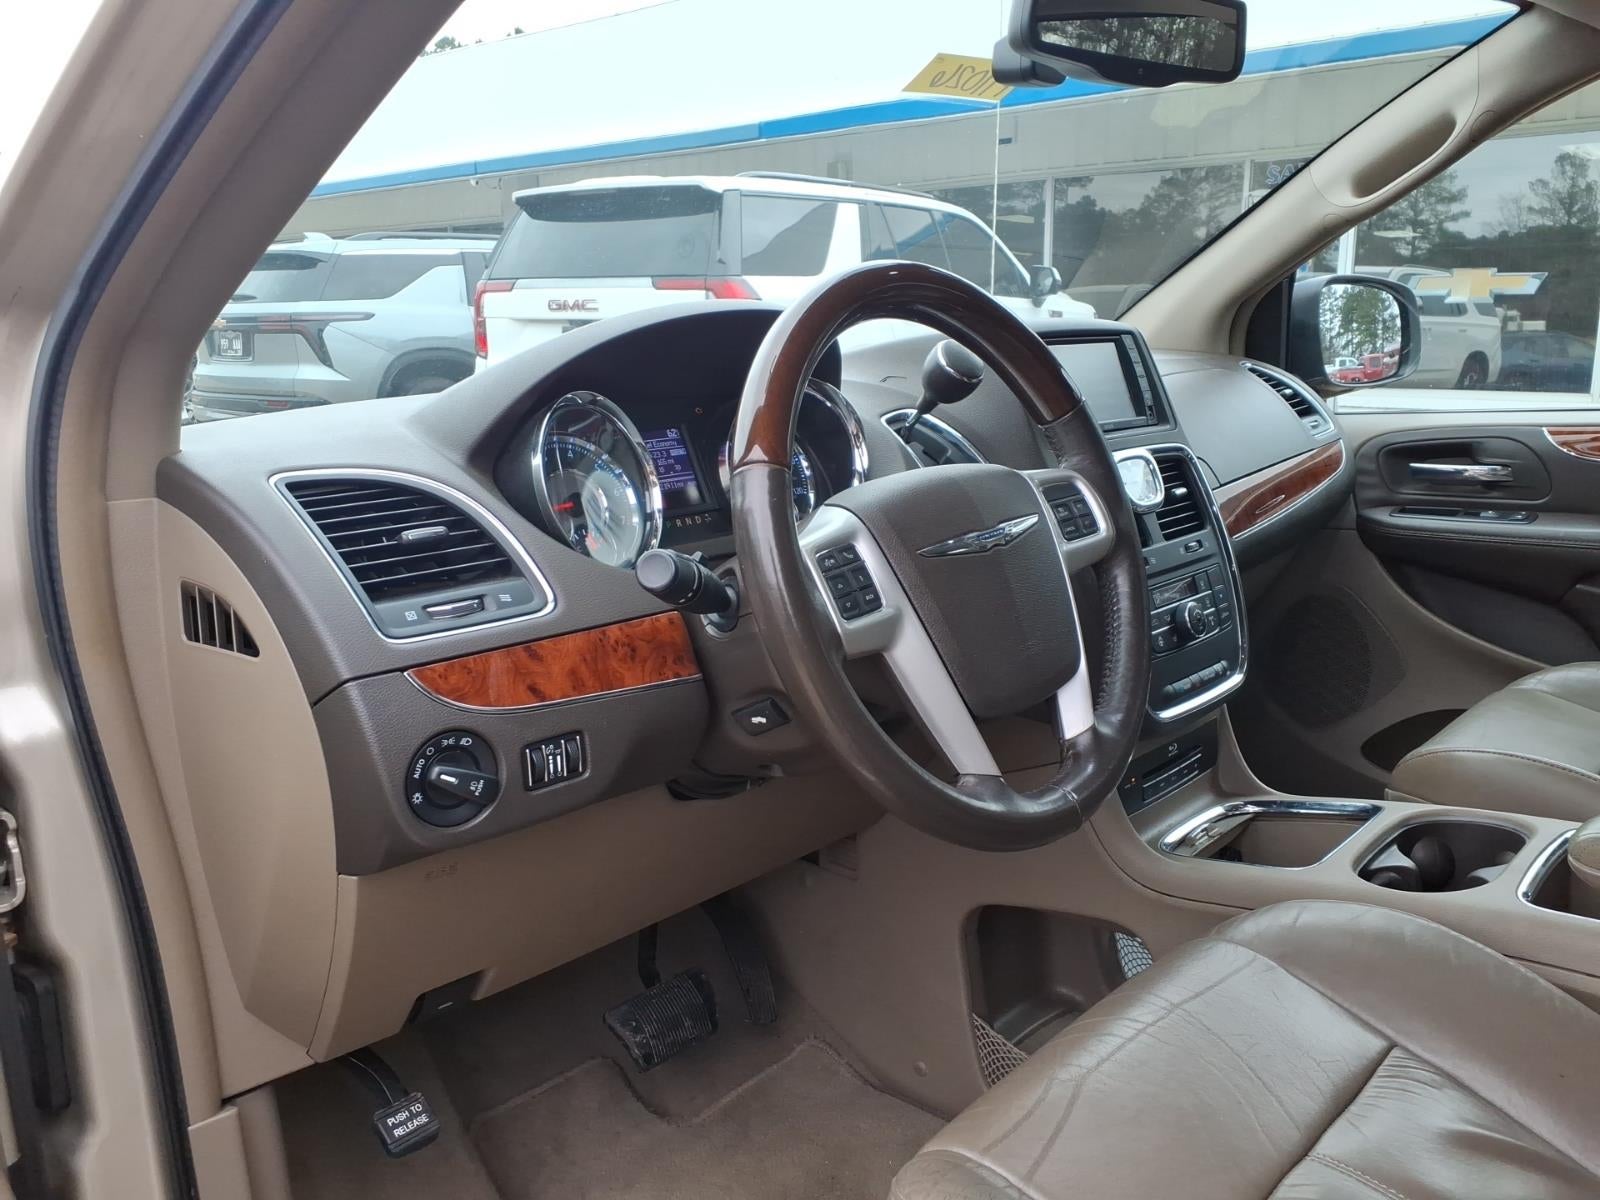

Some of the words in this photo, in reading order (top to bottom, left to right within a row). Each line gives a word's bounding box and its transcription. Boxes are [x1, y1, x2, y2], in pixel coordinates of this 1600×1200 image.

[1265, 163, 1305, 185] SA
[547, 299, 600, 313] GMC
[413, 758, 425, 779] AUTO
[475, 779, 485, 796] PUSH
[386, 1110, 410, 1127] PUSH
[409, 1103, 423, 1114] TO
[393, 1113, 430, 1138] RELEASE
